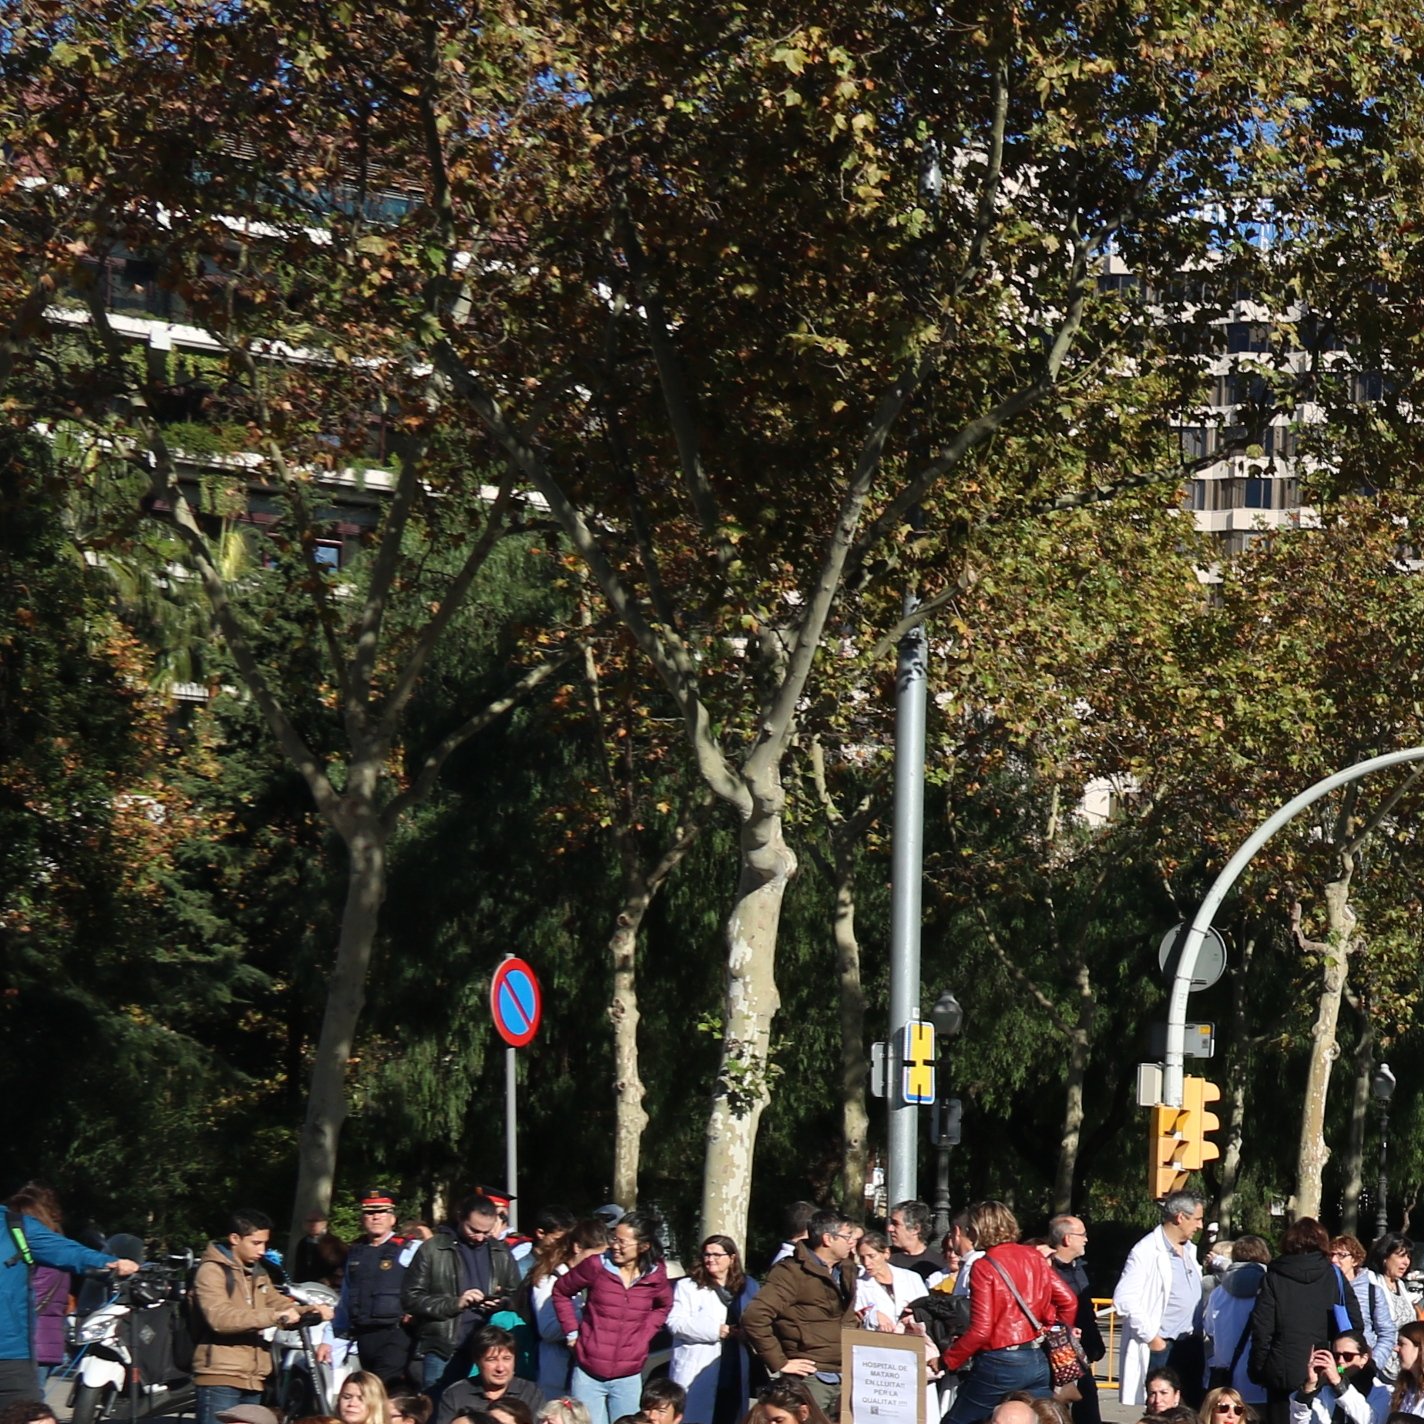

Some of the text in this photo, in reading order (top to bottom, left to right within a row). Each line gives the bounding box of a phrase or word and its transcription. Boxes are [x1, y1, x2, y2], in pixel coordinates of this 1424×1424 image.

[862, 1361, 897, 1371] HOSPITAL
[873, 1388, 887, 1396] PER
[862, 1397, 897, 1406] QUALITAT
